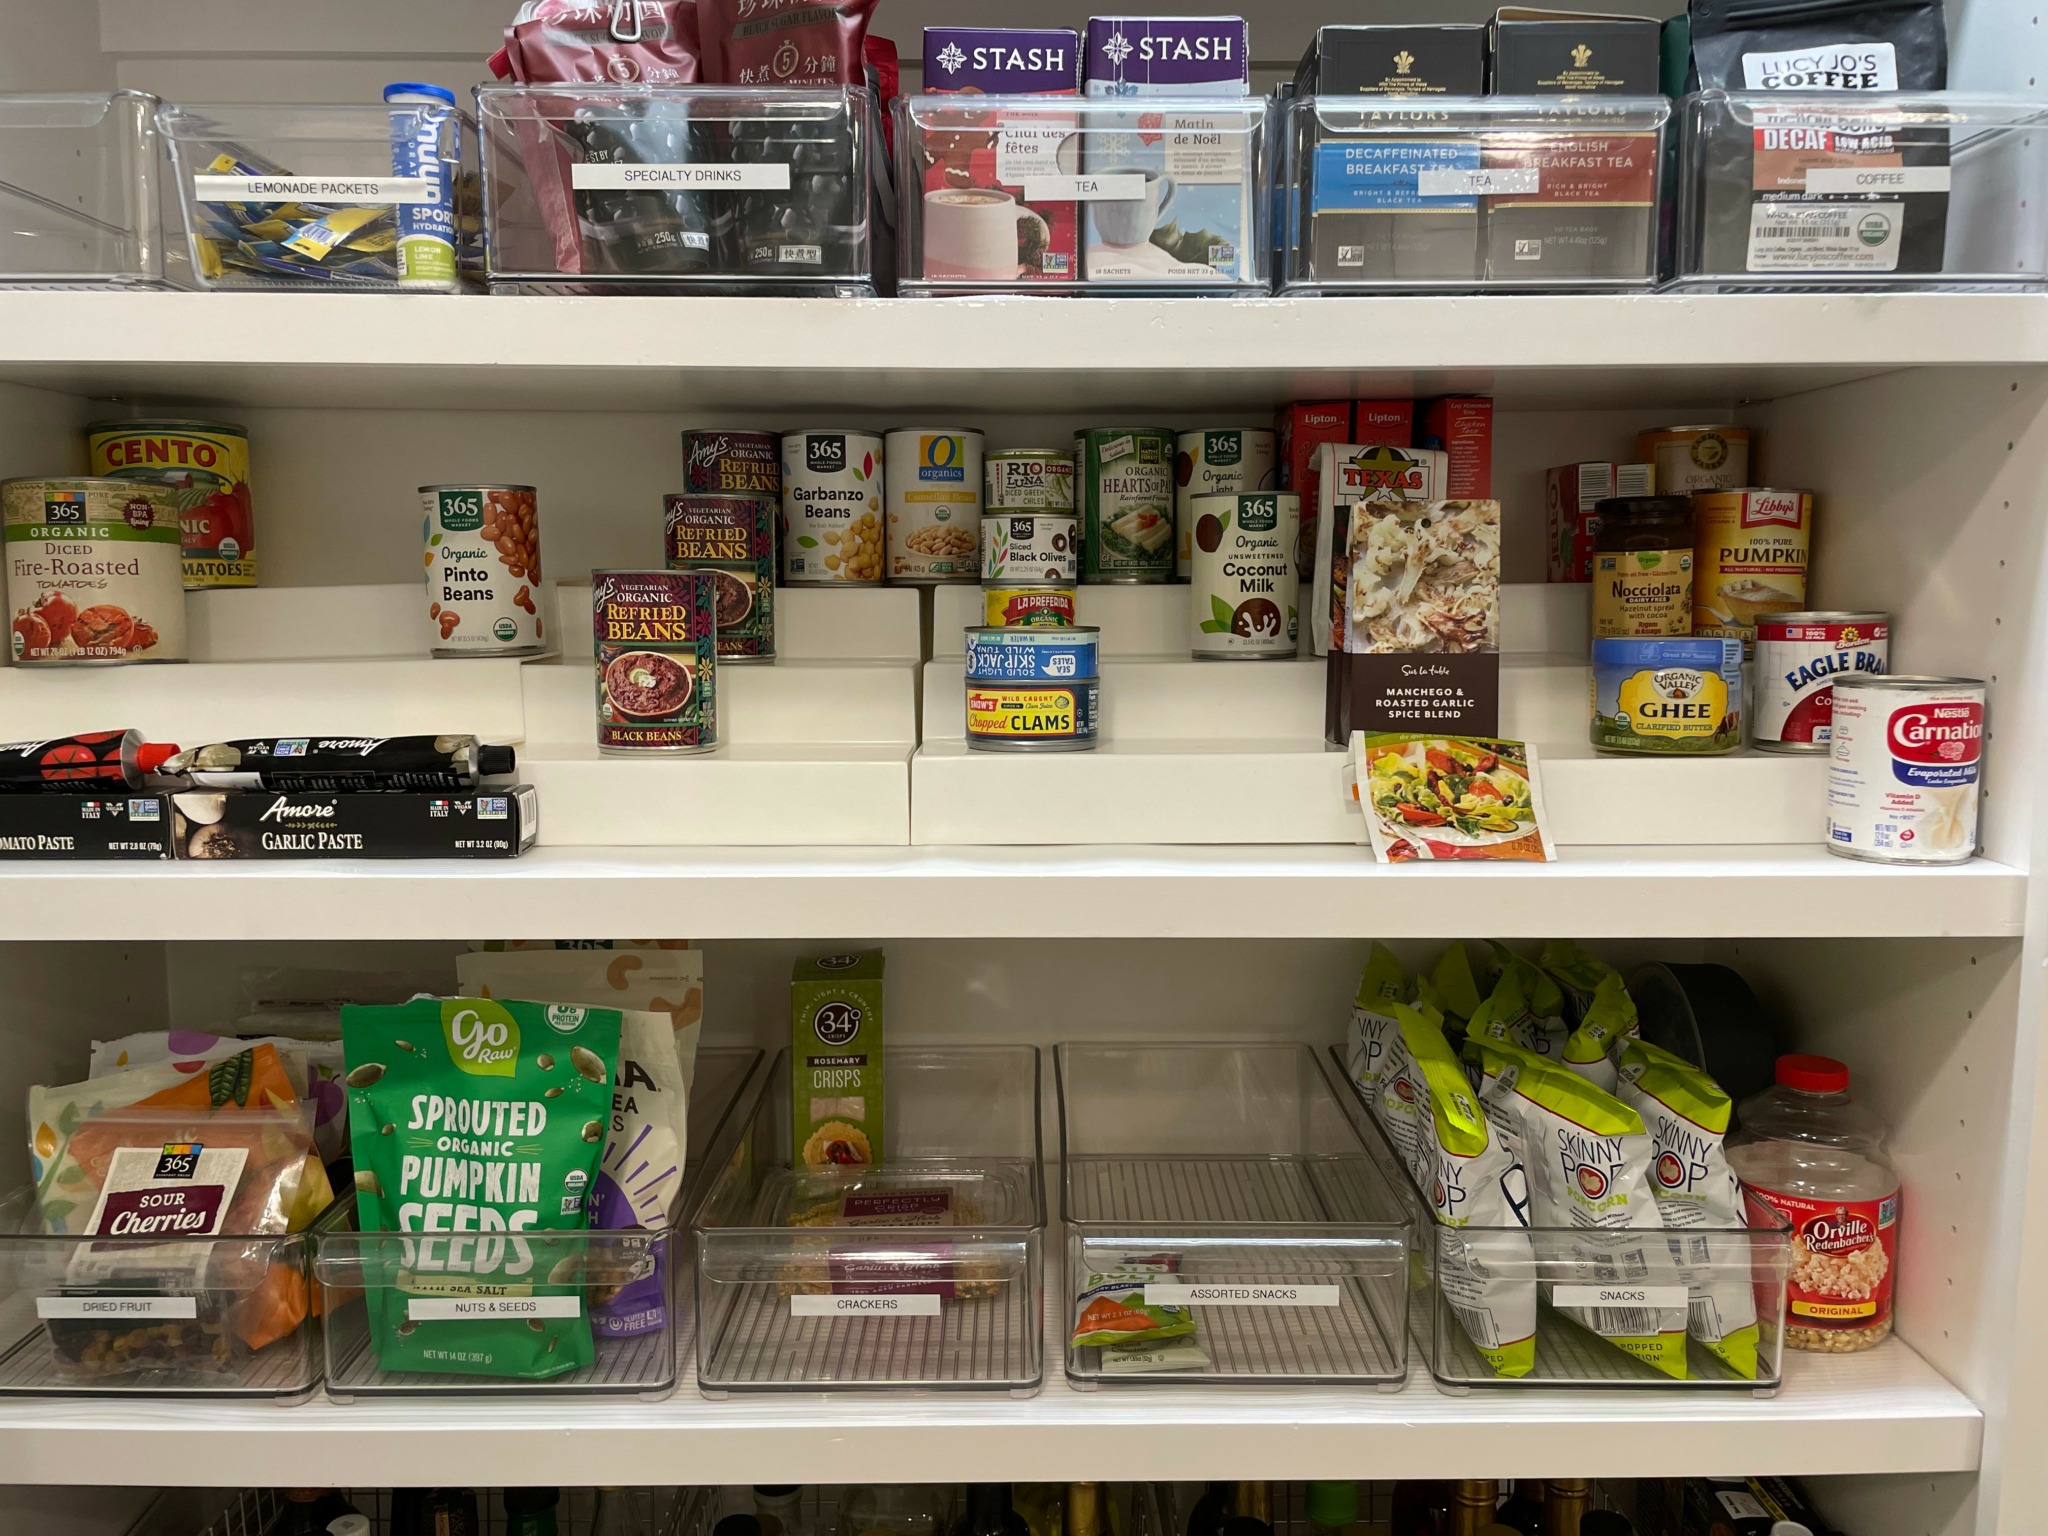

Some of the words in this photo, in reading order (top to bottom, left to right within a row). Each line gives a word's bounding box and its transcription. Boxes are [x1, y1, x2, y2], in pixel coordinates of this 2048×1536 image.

[1140, 37, 1231, 61] STASH
[973, 48, 1064, 71] STASH
[1762, 72, 1878, 89] COFFEE
[1174, 134, 1189, 145] de
[1193, 133, 1221, 145] Noël
[1764, 128, 1829, 150] DECAF
[1005, 141, 1039, 154] fêtes
[1345, 148, 1458, 160] DECAFFEINATED
[1346, 164, 1425, 175] BREAKFAST
[1523, 157, 1602, 168] BREAKFAST
[1608, 157, 1633, 168] TEA
[624, 170, 691, 181] SPECIALTY
[695, 170, 742, 181] DRINKS
[1469, 176, 1492, 186] TEA
[1856, 173, 1905, 184] COFFEE
[248, 182, 317, 195] LEMONADE
[321, 182, 379, 195] PACKETS
[1074, 181, 1098, 192] TEA
[1762, 192, 1800, 201] medium
[1802, 192, 1823, 201] dark
[413, 207, 454, 223] SPORT
[414, 245, 441, 255] LEMON
[1772, 253, 1874, 262] www.lucyjoscoffee.com
[1305, 414, 1337, 425] Lipton
[1368, 413, 1401, 424] Lipton
[810, 441, 842, 458] 365
[1207, 436, 1238, 453] 365
[106, 439, 217, 467] CENTO
[689, 436, 730, 475] Amy's
[730, 449, 773, 460] ORGANIC
[921, 469, 962, 479] organics
[1006, 462, 1043, 476] RIO
[720, 474, 780, 492] BEANS
[1202, 469, 1244, 485] Organic
[1343, 469, 1423, 489] TEXAS
[1103, 478, 1150, 493] HEARTS
[1159, 478, 1173, 493] PAL
[793, 486, 864, 501] Garbanzo
[907, 493, 951, 501] Cannellini
[50, 502, 80, 519] 365
[443, 497, 479, 517] 365
[805, 504, 851, 518] Beans
[1241, 499, 1274, 518] 365
[685, 514, 735, 526] ORGANIC
[30, 527, 109, 538] ORGANIC
[677, 525, 747, 541] REFRIED
[45, 542, 93, 555] DICED
[1009, 543, 1032, 551] Sliced
[1235, 535, 1279, 551] Organic
[441, 547, 488, 563] Organic
[677, 542, 747, 560] BEANS
[1009, 552, 1038, 562] Black
[1040, 552, 1067, 562] Olives
[1228, 552, 1284, 560] UNSWEETENED
[1719, 548, 1807, 563] PUMPKIN
[14, 559, 139, 576] Fire-Roasted
[182, 562, 242, 577] MATOES
[444, 566, 489, 582] Pinto
[1222, 562, 1288, 577] Coconut
[36, 579, 108, 589] TOMATOES
[1239, 578, 1275, 593] Milk
[1612, 580, 1681, 597] Nocciolata
[443, 586, 494, 601] Beans
[616, 592, 673, 603] ORGANIC
[1017, 597, 1029, 610] LA
[1030, 596, 1069, 608] PREFERIDA
[1619, 604, 1653, 612] Hazelnut
[1654, 604, 1675, 613] spread
[607, 604, 687, 621] REFRIED
[607, 622, 687, 641] BEANS
[1785, 652, 1850, 692] EAGLE
[1854, 651, 1887, 676] BRA
[1386, 688, 1453, 696] MANCHEGO
[1456, 688, 1464, 696] &
[969, 700, 994, 710] SNOW'S
[1375, 699, 1429, 707] ROASTED
[1433, 699, 1475, 707] GARLIC
[1639, 702, 1711, 718] GHEE
[1388, 710, 1421, 718] SPICE
[1424, 710, 1461, 718] BLEND
[1934, 707, 1970, 719] Nestlé
[969, 713, 1008, 731] Chopped
[1011, 714, 1070, 731] CLAMS
[611, 730, 645, 742] BLACK
[646, 730, 682, 742] BEANS
[259, 796, 335, 822] Amore
[37, 835, 75, 850] PASTE
[261, 832, 316, 850] GARLIC
[318, 832, 363, 850] PASTE
[455, 840, 466, 848] NET
[467, 840, 475, 848] WT
[476, 840, 485, 848] 3.2
[486, 840, 493, 848] OZ
[493, 840, 509, 849] (90g)
[478, 1047, 514, 1064] Raw
[814, 1057, 861, 1065] ROSEMARY
[813, 1070, 861, 1088] CRISPS
[408, 1094, 547, 1136] SPROUTED
[436, 1135, 514, 1157] ORGANIC
[1557, 1128, 1624, 1164] SKINNY
[1655, 1115, 1713, 1164] SKINNY
[160, 1155, 191, 1173] 365
[400, 1155, 541, 1203] PUMPKIN
[139, 1192, 185, 1208] SOUR
[854, 1197, 941, 1206] PERFECTLY
[111, 1208, 207, 1235] Cherries
[1813, 1219, 1868, 1240] Orville
[1803, 1232, 1874, 1252] Redenbacher's
[1190, 1289, 1250, 1299] ASSORTED
[1253, 1289, 1297, 1299] SNACKS
[1599, 1291, 1645, 1301] SNACKS
[83, 1302, 117, 1312] DRIED
[120, 1302, 152, 1312] FRUIT
[455, 1301, 485, 1312] NUTS
[487, 1301, 496, 1312] &
[499, 1301, 537, 1312] SEEDS
[837, 1300, 898, 1309] CRACKERS
[1810, 1306, 1864, 1315] ORIGINAL
